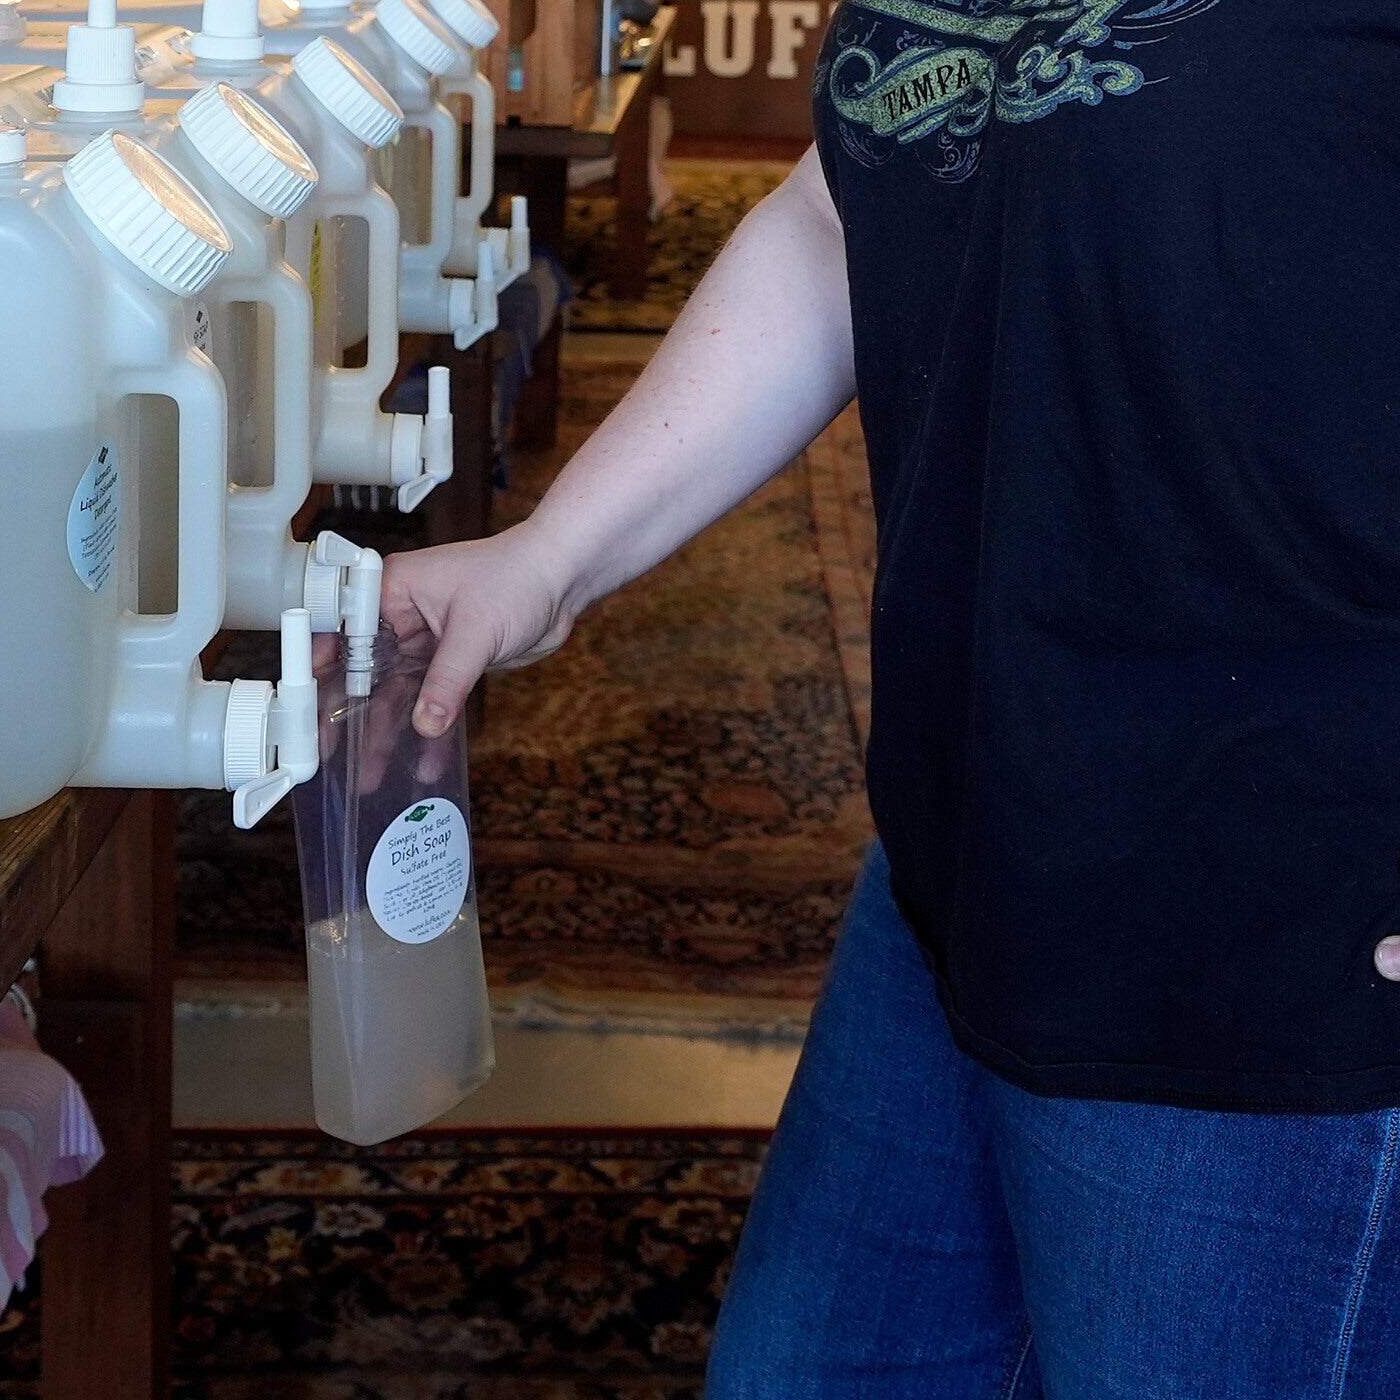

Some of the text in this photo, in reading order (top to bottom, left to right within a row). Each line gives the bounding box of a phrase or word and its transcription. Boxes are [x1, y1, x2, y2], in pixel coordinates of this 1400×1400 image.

[662, 0, 839, 80] LUF
[882, 58, 972, 120] TAMPA
[388, 814, 452, 850] Simply The Best
[391, 829, 452, 867] Dish Soap
[400, 849, 447, 876] Sulfate Free
